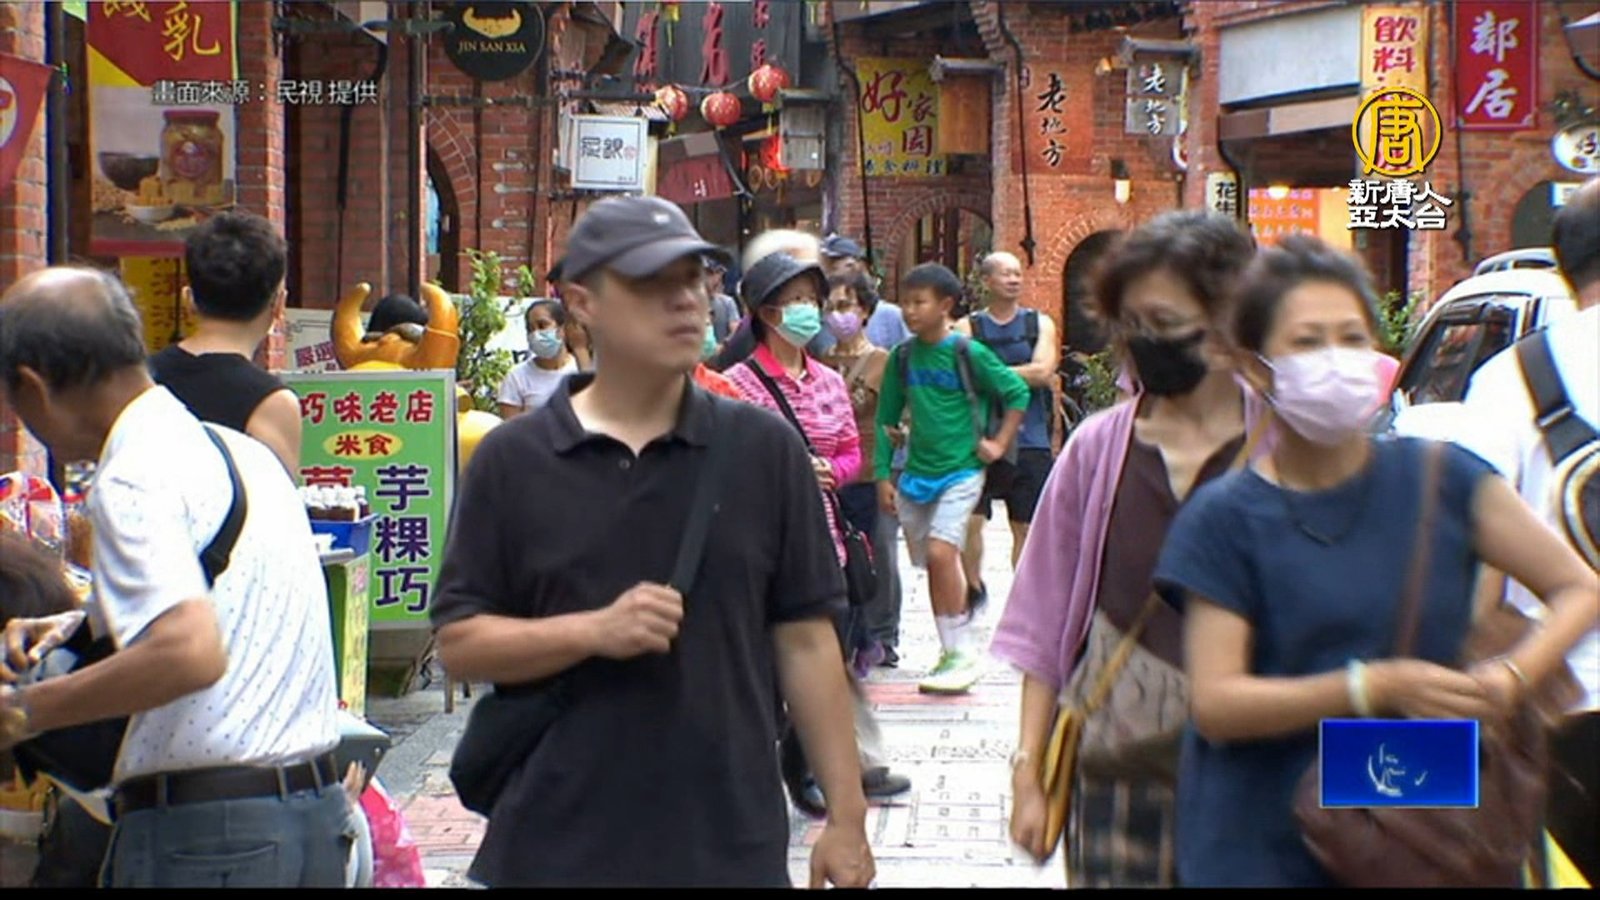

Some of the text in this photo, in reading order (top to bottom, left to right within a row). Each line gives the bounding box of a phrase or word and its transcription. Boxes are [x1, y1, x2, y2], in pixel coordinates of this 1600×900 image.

[161, 1, 221, 61] 乳
[458, 41, 476, 54] JIN
[480, 41, 503, 52] SAN
[1464, 10, 1520, 118] 鄰居
[1036, 71, 1067, 168] 老地方
[1143, 62, 1166, 135] 老地方
[300, 390, 434, 424] 巧味老店
[335, 434, 394, 456] 米食
[375, 464, 431, 613] 芋粿巧
